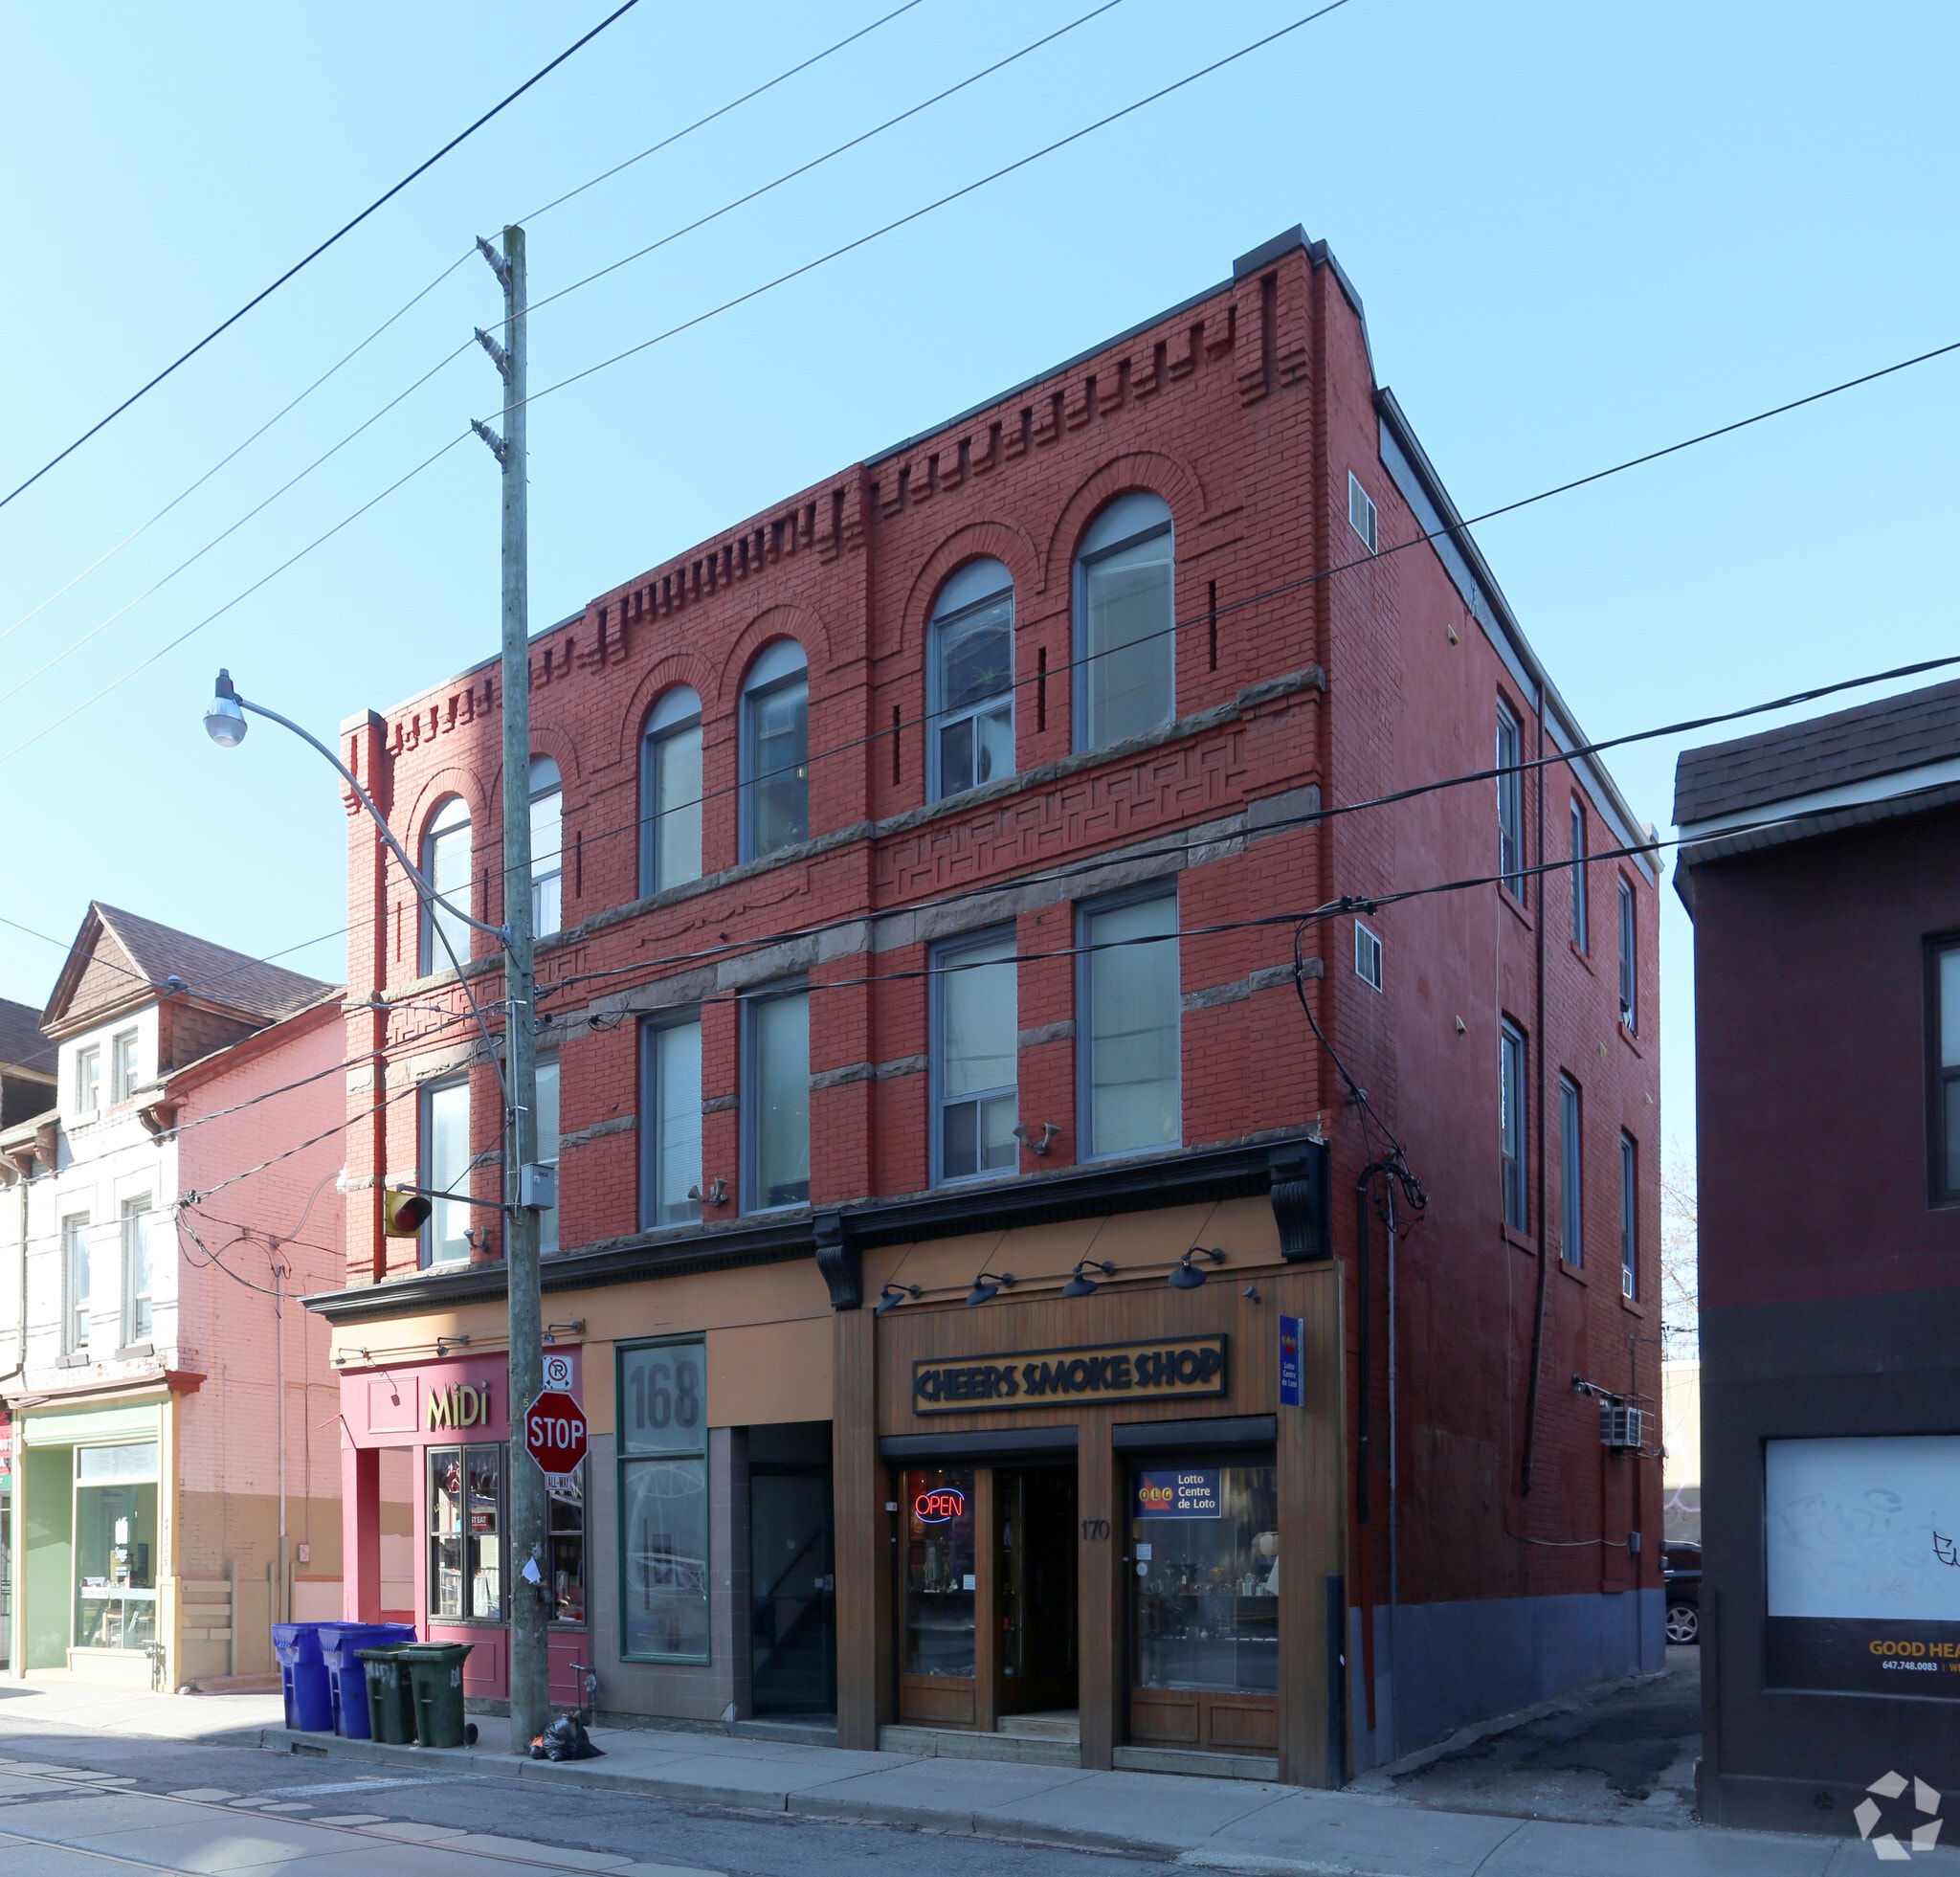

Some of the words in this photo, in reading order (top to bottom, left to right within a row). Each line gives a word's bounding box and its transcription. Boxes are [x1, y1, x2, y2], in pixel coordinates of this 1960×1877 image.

[916, 1365, 1019, 1402] CHEERS
[1022, 1354, 1132, 1396] SMOKE
[1134, 1347, 1221, 1387] SHOP
[630, 1360, 700, 1429] 168
[530, 1416, 585, 1449] STOP
[1178, 1474, 1204, 1485] Lotto
[1140, 1488, 1171, 1501] OLG
[1178, 1486, 1211, 1497] Centre
[915, 1494, 962, 1516] OPEN
[1178, 1499, 1191, 1509] de
[1193, 1498, 1215, 1508] Loto
[1081, 1519, 1110, 1541] 170
[1869, 1640, 1926, 1657] GOOD
[1882, 1660, 1938, 1671] 647.748.0083
